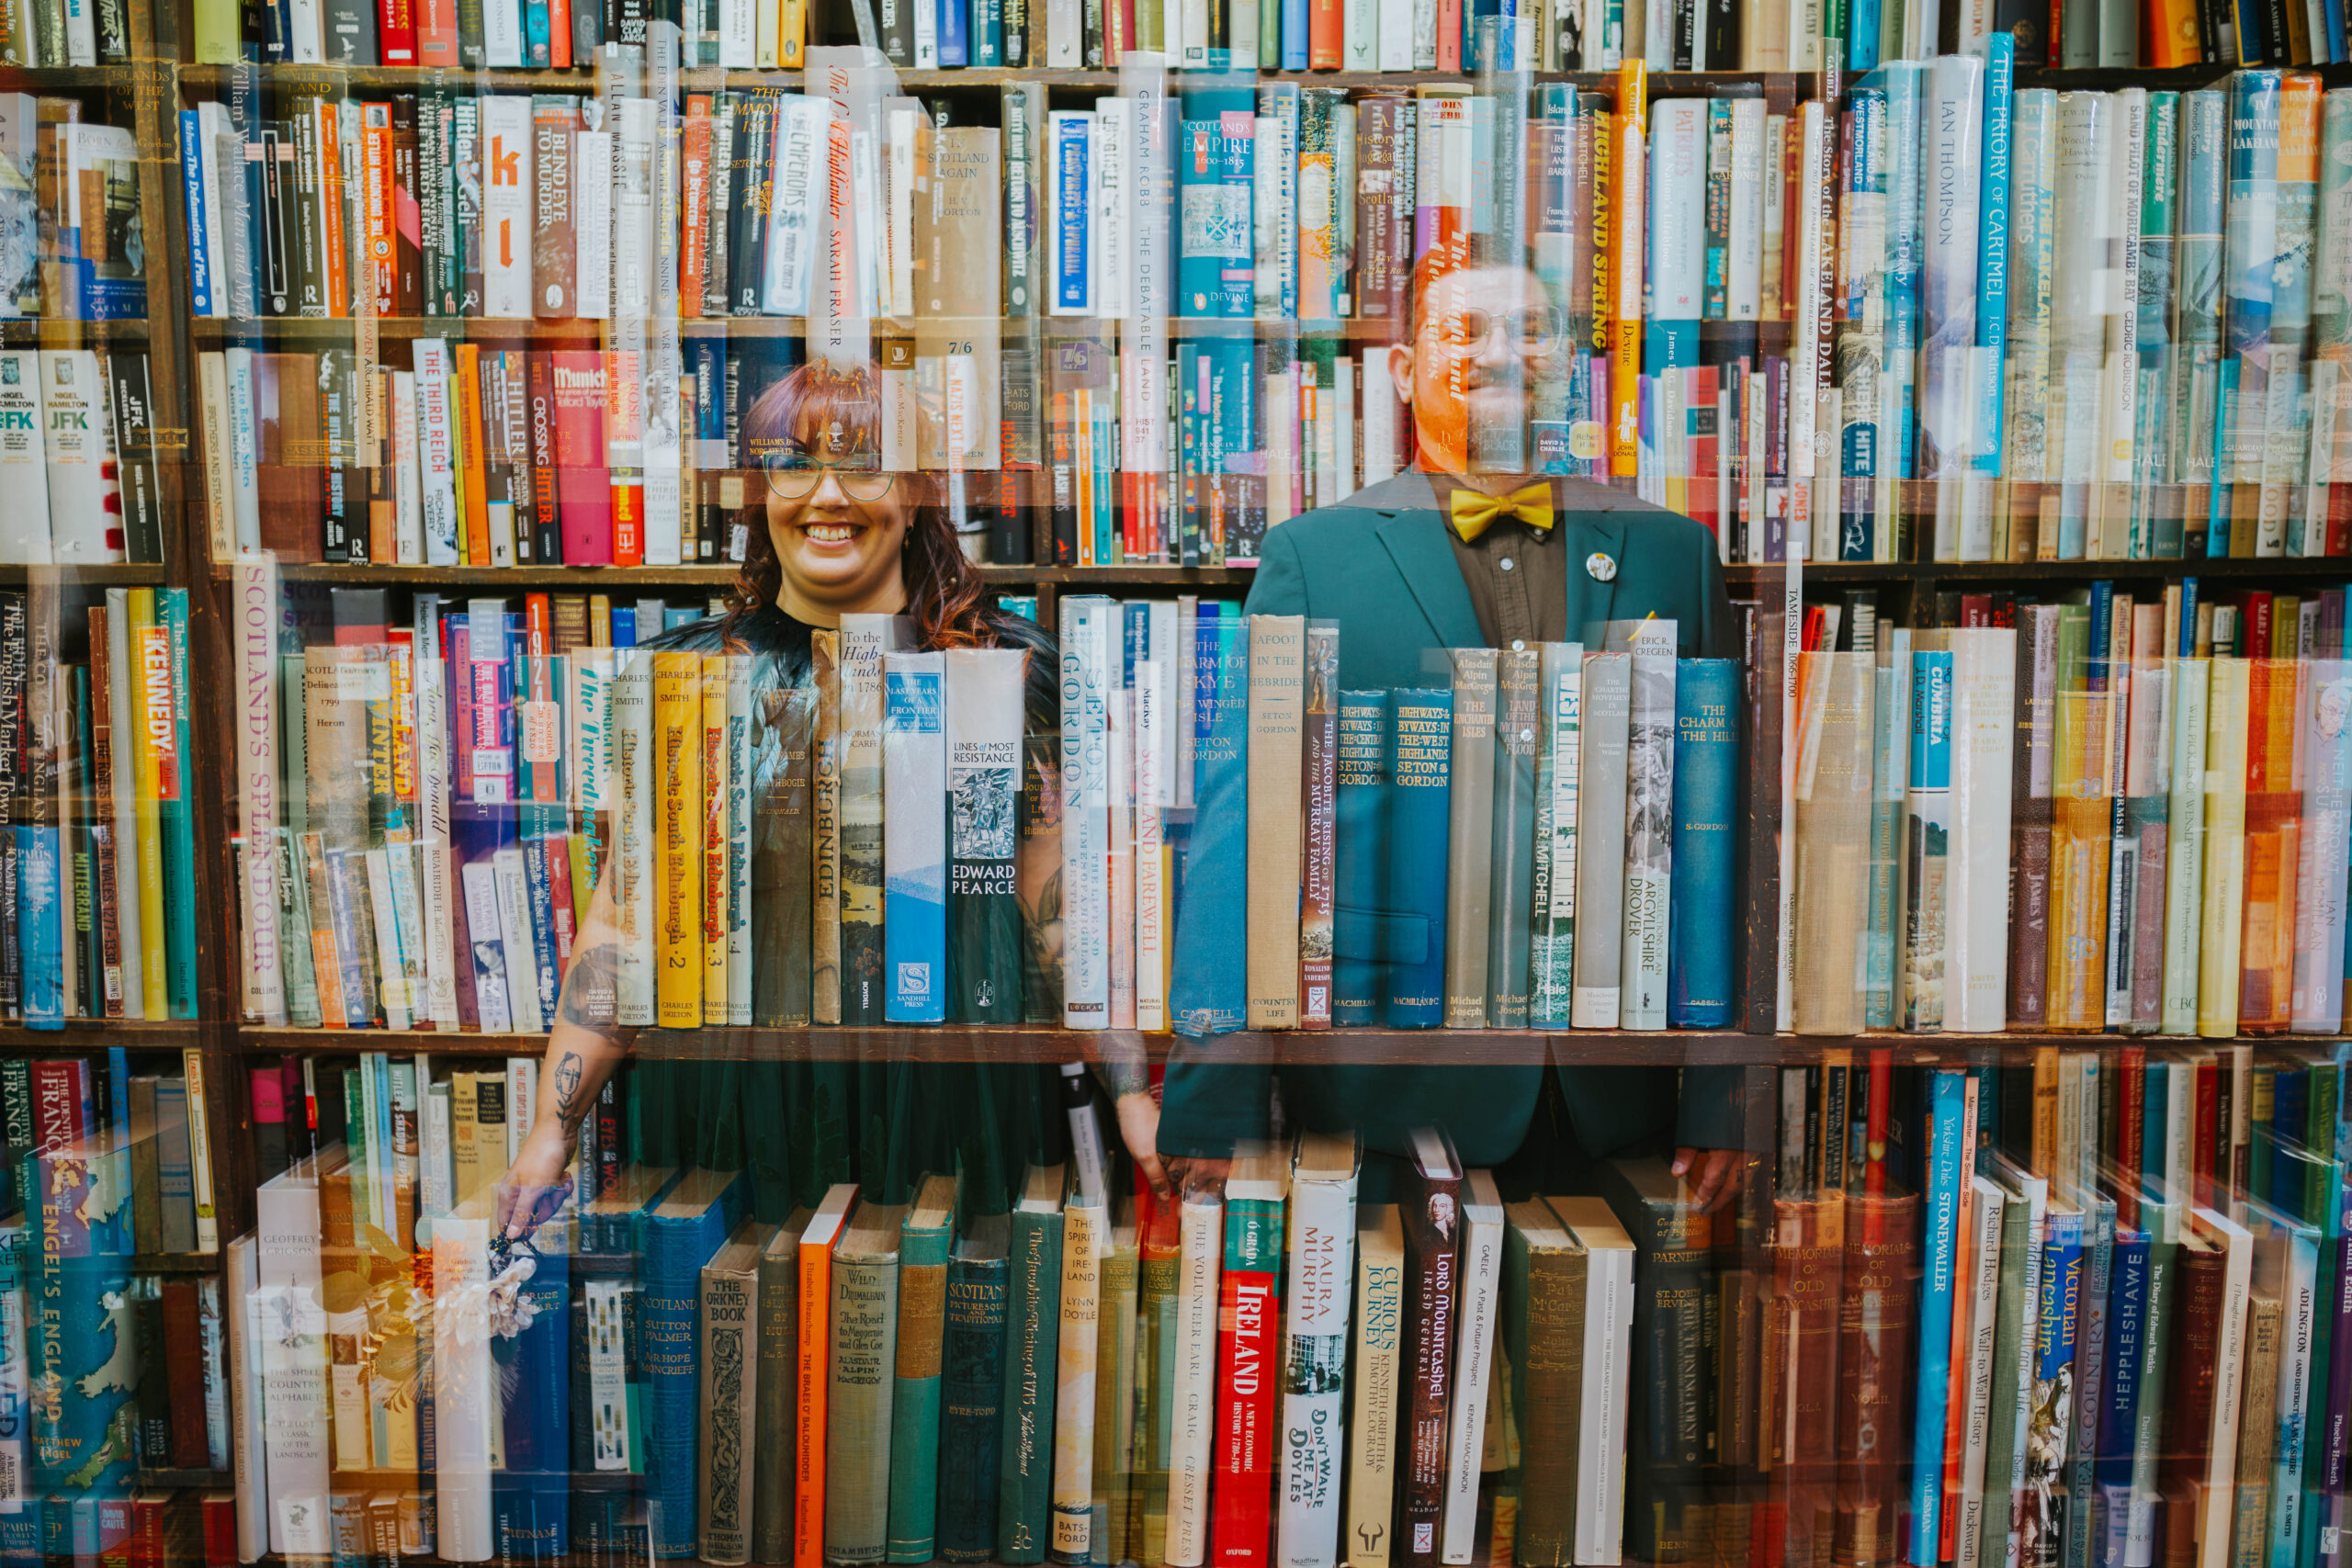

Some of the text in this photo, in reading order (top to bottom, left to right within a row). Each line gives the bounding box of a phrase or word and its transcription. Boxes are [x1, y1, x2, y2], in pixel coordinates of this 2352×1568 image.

[110, 70, 170, 82] ISLANDS
[1826, 54, 1835, 103] GAMBLES
[116, 85, 165, 97] OF THE
[122, 100, 159, 112] WEST
[1546, 104, 1574, 116] Islands
[610, 73, 628, 190] ALLAN MASSIE
[1183, 139, 1250, 154] EMPIRE
[1855, 100, 1864, 185] WESTMORLAND
[927, 152, 989, 164] SCOTLAND
[2154, 104, 2171, 204] Windermere
[551, 132, 567, 223] BLIND EYE
[939, 167, 978, 178] AGAIN
[1547, 167, 1572, 177] BARRA
[1593, 109, 1611, 248] HIGHLAND
[1939, 100, 1956, 246] IAN THOMPSON
[1984, 51, 2008, 302] THE PRIORY OF CARTMEL
[1546, 207, 1570, 217] Francis
[1138, 90, 1151, 402] GRAHAM ROBB THE DEBATABLE LAND
[1817, 116, 1834, 404] The Story of the LAKELAND DALES
[1209, 292, 1250, 304] DEVINE
[1591, 255, 1609, 349] SPRING
[948, 341, 973, 355] 7/6
[2121, 310, 2134, 412] CEDRIC ROBINSON
[53, 391, 78, 400] NIGEL
[47, 400, 88, 409] HAMILTON
[130, 396, 143, 427] JFK
[424, 350, 446, 474] THE THIRD REICH
[50, 411, 88, 430] JFK
[1001, 421, 1016, 517] HOLOCAUST
[844, 632, 881, 643] To the
[1257, 635, 1297, 645] AFOOT
[1788, 588, 1798, 698] TAMESIDE 1066-1700
[843, 646, 884, 663] High-
[1635, 647, 1673, 656] CREGEEN
[1257, 656, 1297, 666] IN THE
[655, 671, 695, 681] CHARLES
[1182, 676, 1236, 689] SKYE
[1250, 676, 1304, 687] HEBRIDES
[143, 637, 173, 750] KENNEDY
[660, 694, 690, 703] SMITH
[890, 706, 937, 715] FRONTIER
[1141, 687, 1151, 731] Mackay
[1702, 705, 1726, 716] THE
[1930, 666, 1942, 747] CUMBRIA
[1261, 712, 1293, 720] SETON
[1453, 714, 1495, 726] ENCHANTED
[1679, 716, 1724, 728] CHARM
[316, 719, 345, 728] Heron
[1256, 725, 1297, 734] GORDON
[954, 742, 1015, 752] LINES of MOST
[1185, 738, 1231, 748] SETON
[954, 752, 1015, 763] RESISTANCE
[1179, 749, 1238, 761] GORDON
[1396, 748, 1448, 761] HIGHLANDS
[245, 567, 275, 975] SCOTLAND'S SPLENDOUR
[1397, 761, 1438, 773] SETON
[1397, 775, 1448, 787] GORDON
[818, 739, 835, 900] EDINBURGH
[1308, 735, 1322, 901] AND THE MURRAY FAMILY
[1318, 720, 1334, 916] THE JACOBITE RISING OF 1715
[1140, 749, 1158, 957] SCOTLAND FAREWELL
[952, 864, 1015, 880] EDWARD
[74, 852, 92, 932] MITTERRAND
[952, 881, 1015, 895] PEARCE
[1629, 878, 1643, 937] DROVER
[1642, 880, 1657, 973] ARGYLLSHIRE
[251, 987, 277, 995] COLLINS
[662, 1001, 693, 1010] CHARLES
[897, 995, 932, 1003] SANDHILL
[1252, 998, 1297, 1007] COUNTRY
[1450, 996, 1483, 1006] Michael
[663, 1010, 693, 1020] SKILTON
[1265, 1010, 1286, 1018] LIFE
[1449, 1006, 1483, 1018] Joseph
[1073, 1219, 1094, 1229] THE
[264, 1235, 316, 1245] GEOFFREY
[1068, 1231, 1097, 1243] SPIRIT
[1934, 1191, 1951, 1293] STONEWALLER
[1075, 1246, 1089, 1256] OF
[1981, 1206, 2001, 1301] Richard Hodges
[1072, 1259, 1092, 1269] IRE-
[1480, 1244, 1490, 1278] GAELIC
[847, 1269, 876, 1284] WILD
[1067, 1271, 1096, 1282] LAND
[1301, 1225, 1318, 1325] MURPHY
[1318, 1235, 1335, 1318] MAURA
[712, 1281, 741, 1292] THE
[949, 1282, 1007, 1298] SCOTLAND
[641, 1298, 697, 1311] SCOTLAND
[707, 1292, 750, 1306] ORKNEY
[1067, 1296, 1094, 1307] LYNN
[2038, 1245, 2065, 1356] Lancashire
[2061, 1257, 2085, 1347] Victorian
[42, 1205, 62, 1421] ENGEL'S ENGLAND
[1365, 1264, 1384, 1349] JOURNEY
[1380, 1266, 1399, 1352] CURIOUS
[710, 1307, 746, 1322] BOOK
[840, 1312, 885, 1325] The Road
[1064, 1309, 1097, 1321] DOYLE
[2297, 1286, 2309, 1354] ADLINGTON
[645, 1319, 691, 1330] SUTTON
[644, 1332, 692, 1343] PALMER
[2114, 1253, 2143, 1411] HEPPLESHAWE
[1234, 1283, 1269, 1396] IRELAND
[838, 1357, 881, 1366] ALASDAIR
[1181, 1220, 1206, 1560] THE VOLUNTEER EARL CRAIG CRESSET PRESS
[1288, 1427, 1308, 1503] DOYLES
[1461, 1438, 1471, 1493] MACKINNON
[1921, 1473, 1932, 1533] DALESMAN
[1058, 1521, 1088, 1533] BATS-
[1963, 1500, 1980, 1562] Duckworth
[1058, 1532, 1087, 1544] FORD
[828, 1544, 885, 1555] CHAMBERS
